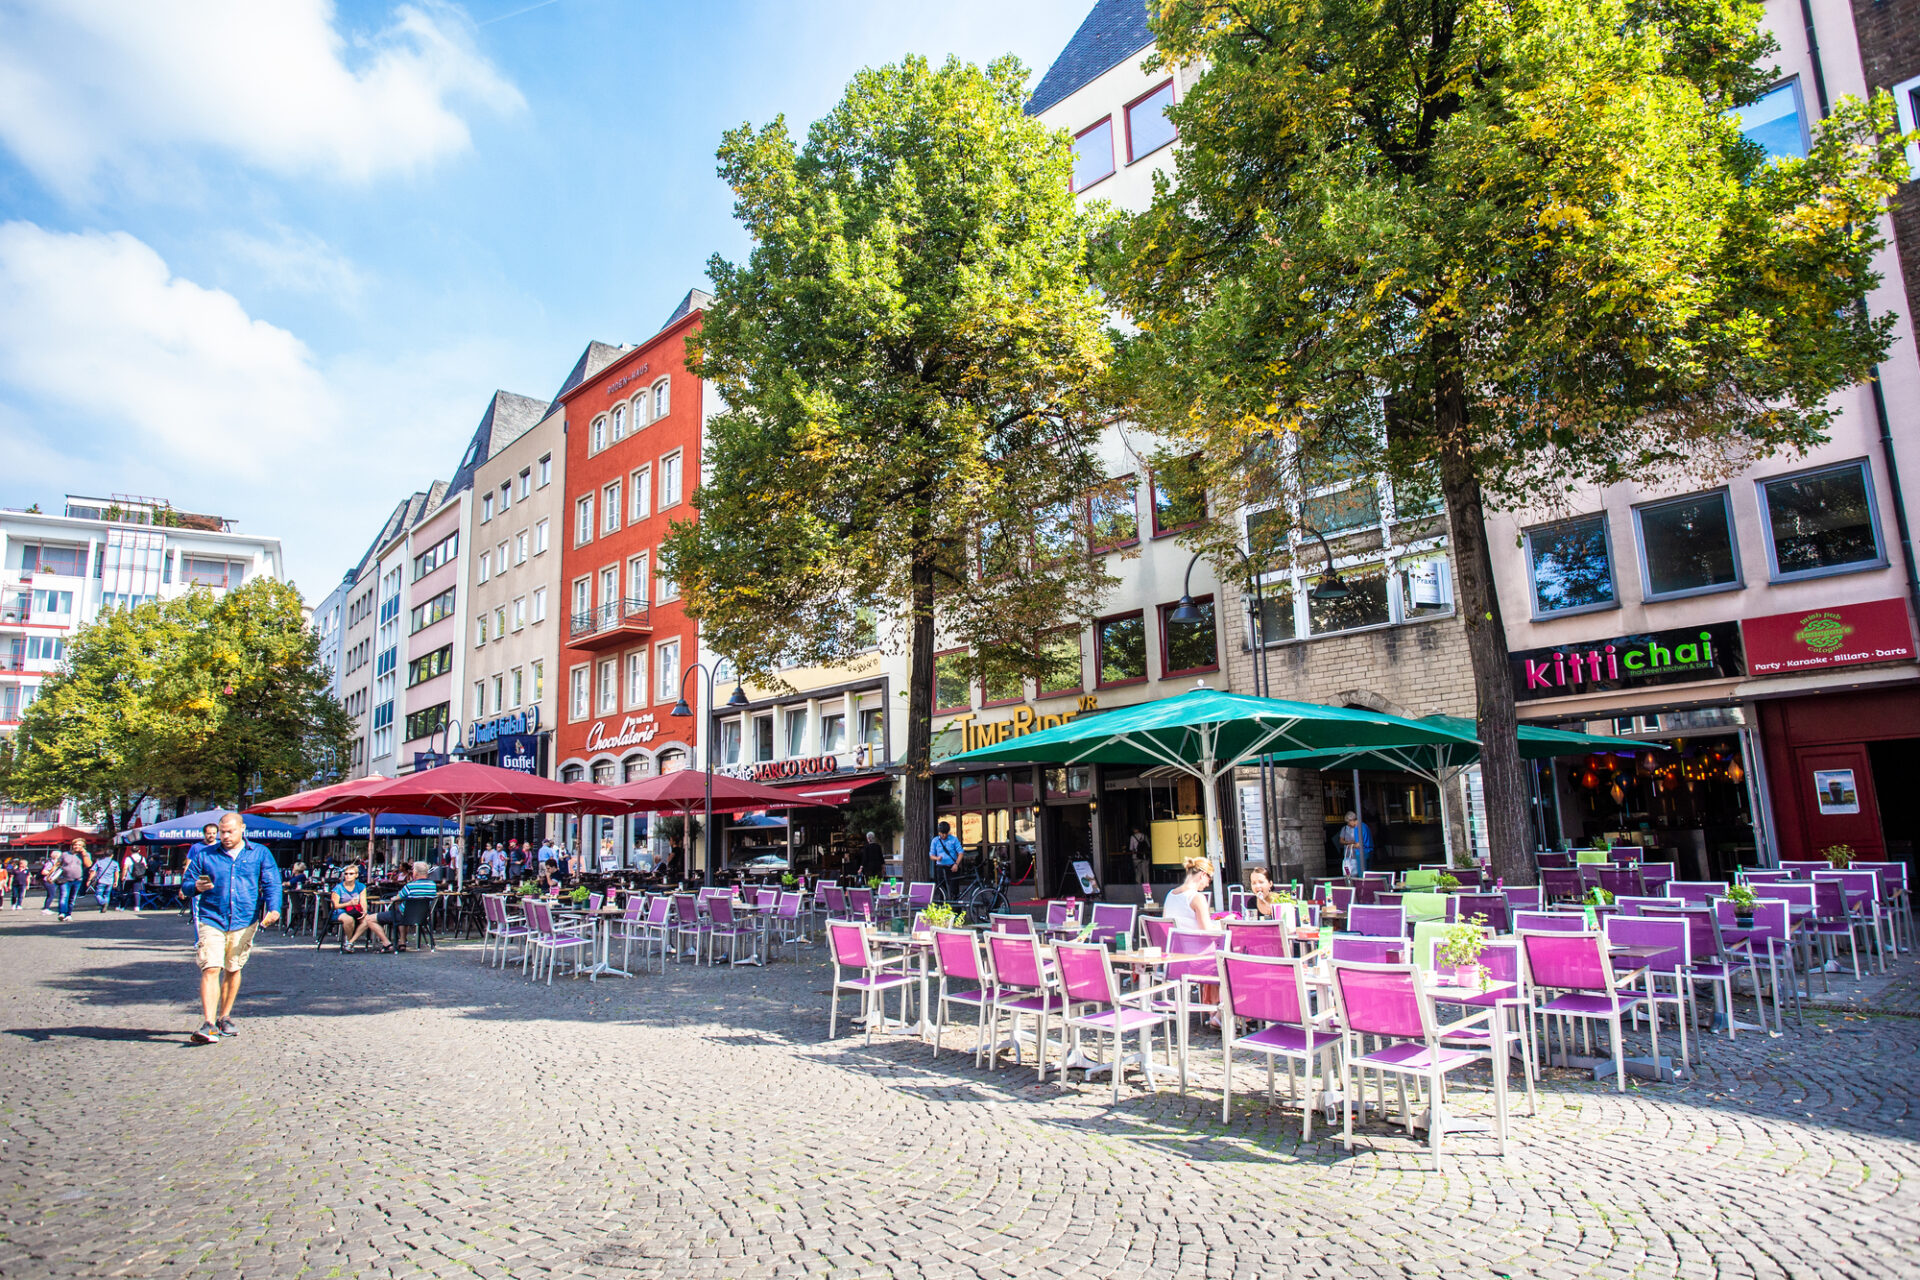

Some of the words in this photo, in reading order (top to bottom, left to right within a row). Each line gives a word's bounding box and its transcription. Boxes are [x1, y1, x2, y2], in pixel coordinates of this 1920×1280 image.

[1525, 645, 1619, 689] kitti
[1623, 631, 1714, 669] chai
[1755, 662, 1780, 671] Party
[1786, 657, 1828, 667] Karaoke
[1834, 652, 1869, 662] Billard
[1875, 648, 1908, 657] Darts
[1663, 663, 1689, 672] kitchen
[1077, 695, 1099, 712] VR
[586, 716, 654, 753] Chocolaterie
[503, 755, 535, 769] Gaffel
[753, 760, 799, 780] MARCO
[799, 756, 836, 774] POLO
[159, 829, 184, 838] Gaffel
[267, 829, 292, 839] Kölsch
[353, 826, 371, 835] Gaffe
[374, 826, 397, 835] Kölsch
[420, 826, 440, 835] Gaffel
[1177, 832, 1202, 849] 429
